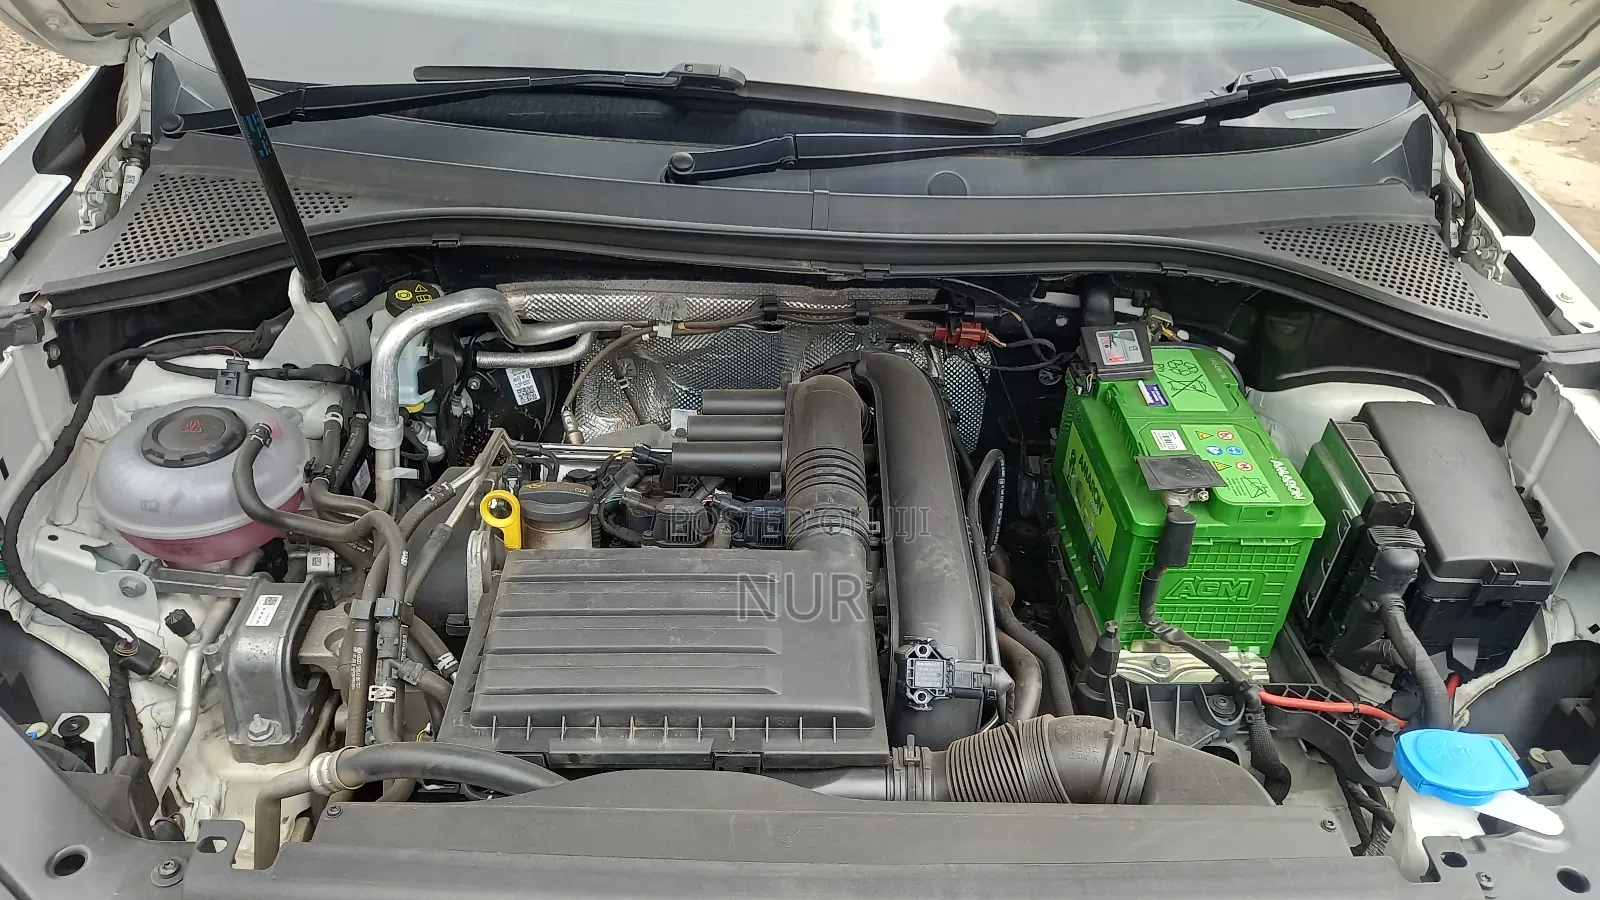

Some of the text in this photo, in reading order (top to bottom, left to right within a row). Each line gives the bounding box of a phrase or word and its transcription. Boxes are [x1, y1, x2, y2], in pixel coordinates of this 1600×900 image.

[1078, 453, 1105, 516] AMARON
[1269, 459, 1307, 500] AMARON
[1170, 581, 1251, 597] AGM
